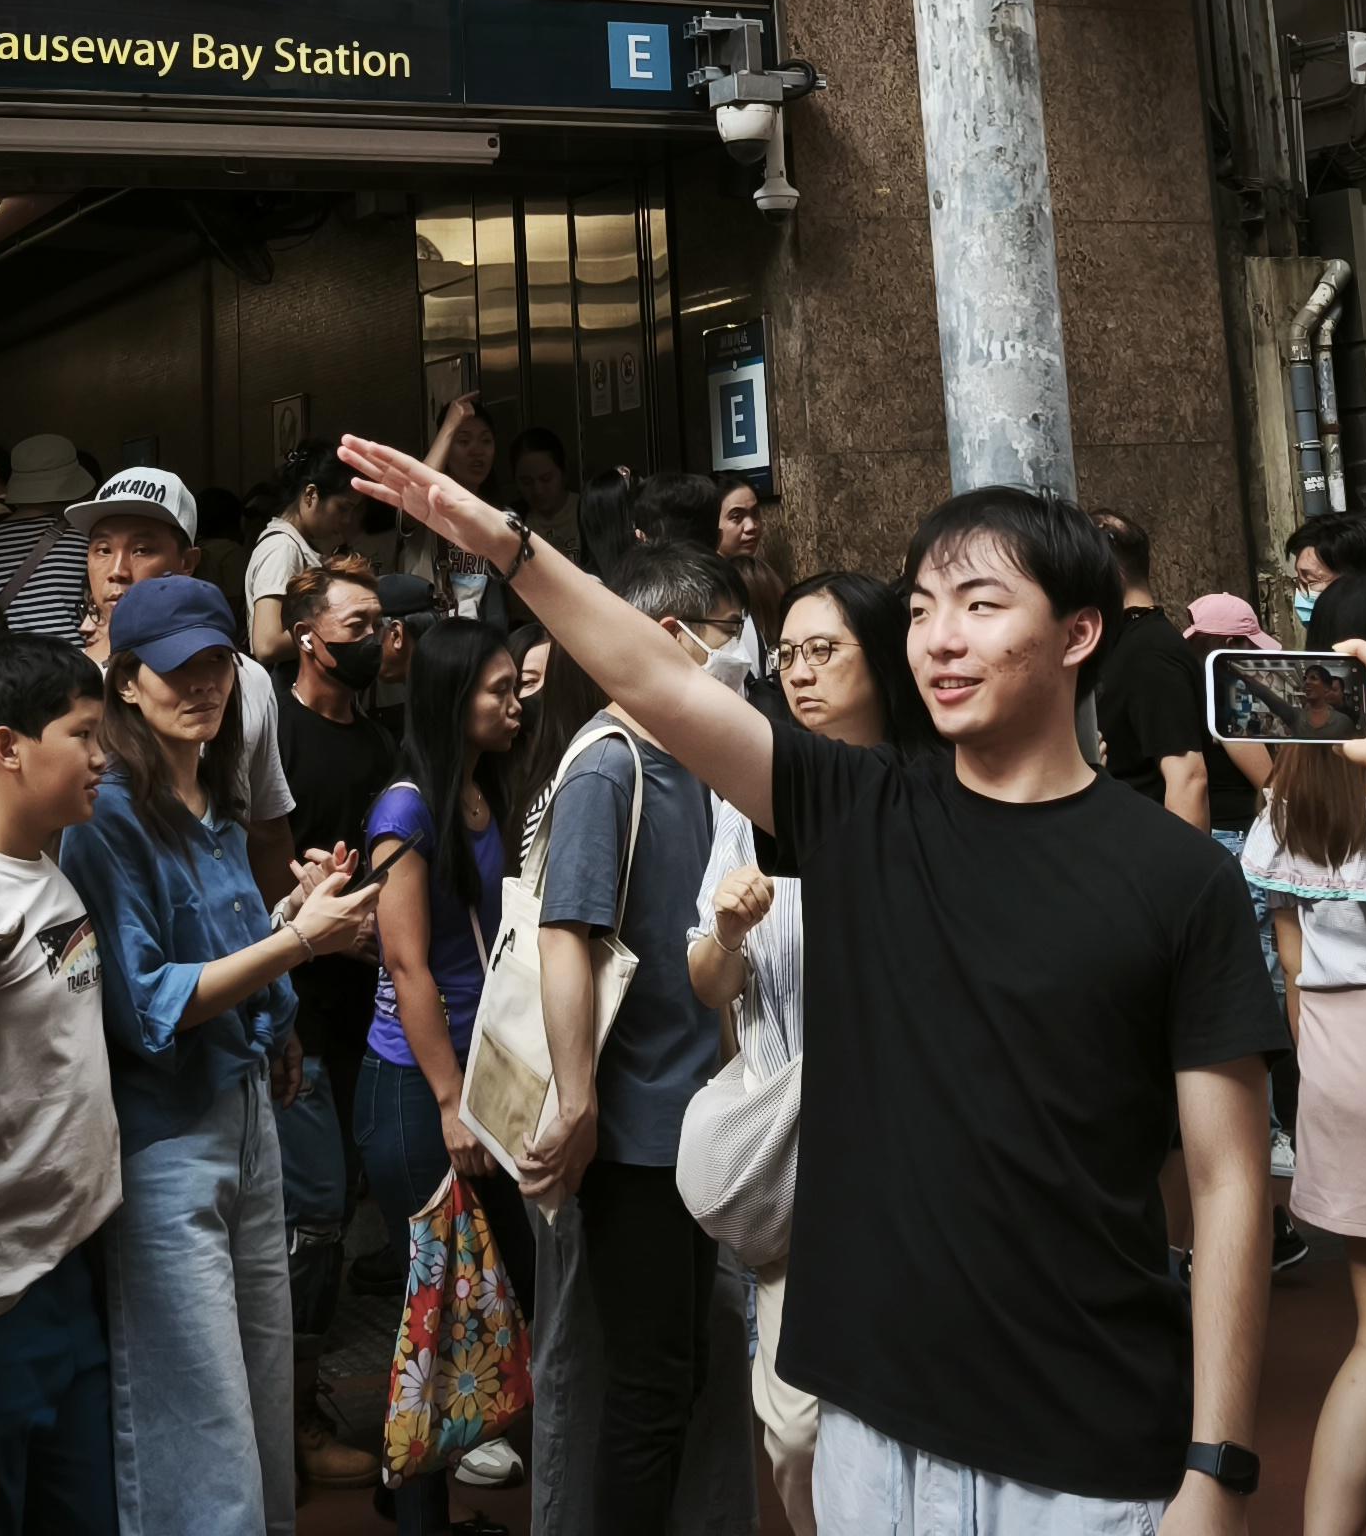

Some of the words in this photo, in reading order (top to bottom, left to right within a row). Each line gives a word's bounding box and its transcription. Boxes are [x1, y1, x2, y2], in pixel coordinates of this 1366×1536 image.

[191, 32, 263, 81] Bay
[274, 36, 412, 79] Station
[625, 34, 655, 81] E
[730, 394, 747, 444] E
